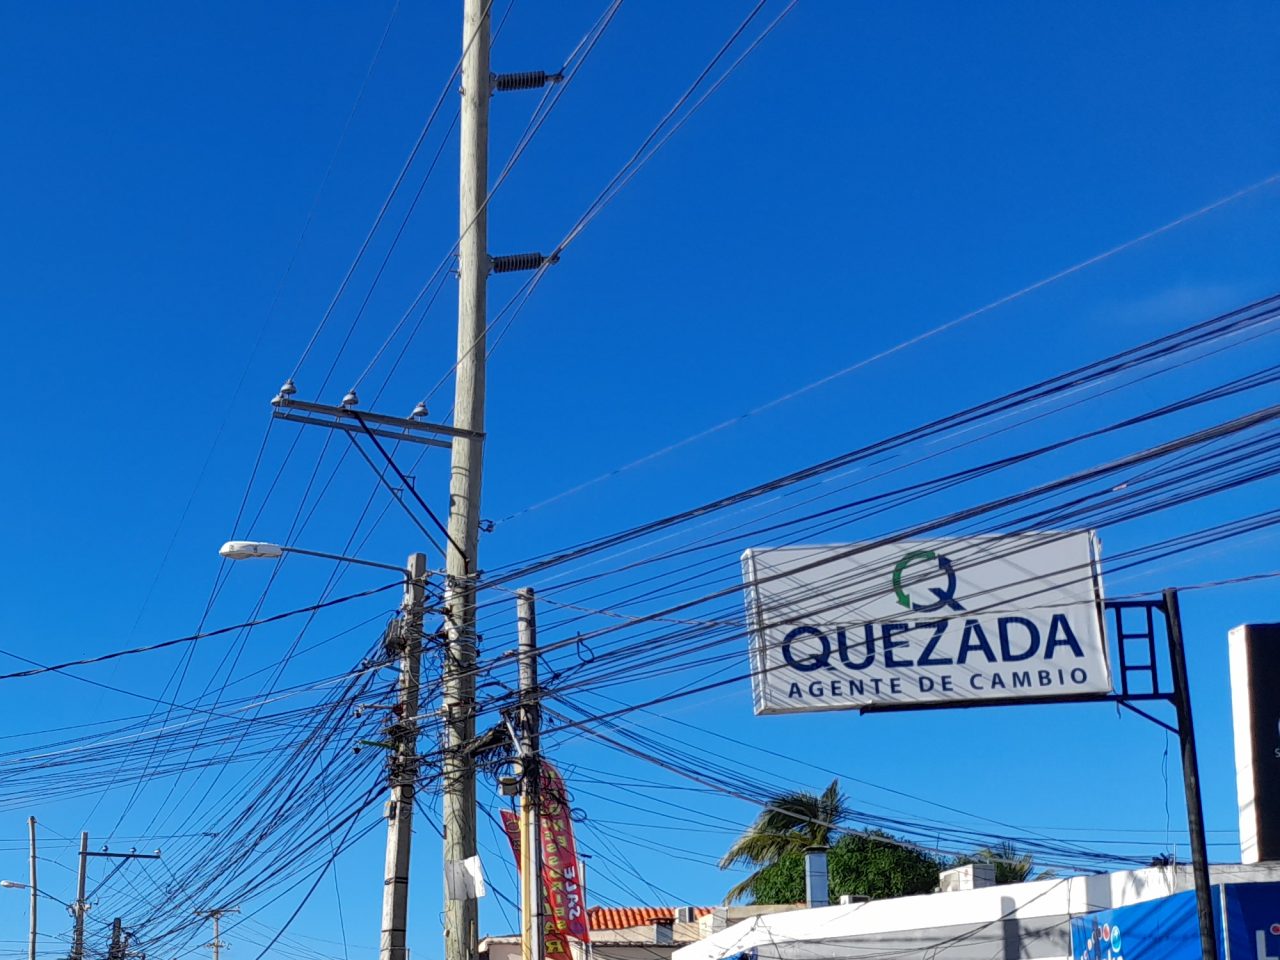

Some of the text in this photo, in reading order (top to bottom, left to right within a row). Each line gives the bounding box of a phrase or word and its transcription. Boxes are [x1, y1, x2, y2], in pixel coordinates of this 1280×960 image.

[781, 613, 1085, 673] QUEZADA
[788, 667, 1089, 699] AGENTE DE CAMBIO
